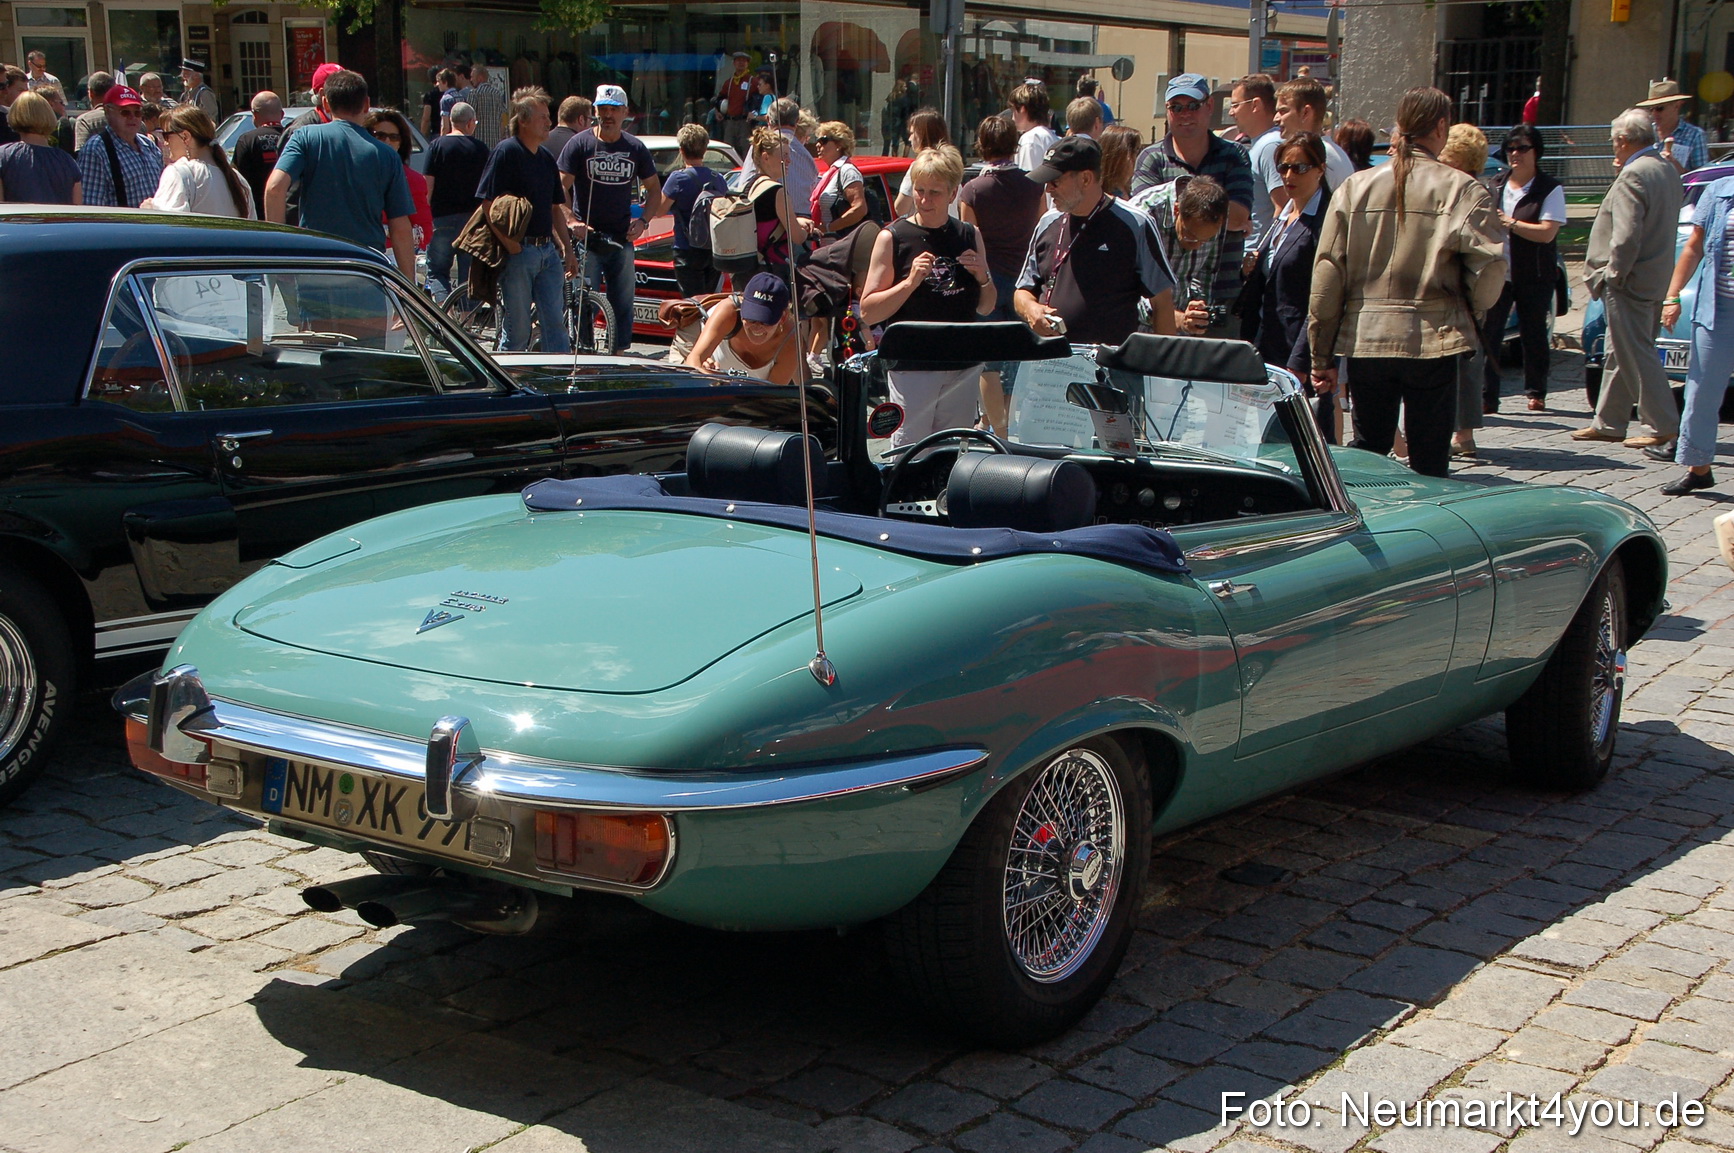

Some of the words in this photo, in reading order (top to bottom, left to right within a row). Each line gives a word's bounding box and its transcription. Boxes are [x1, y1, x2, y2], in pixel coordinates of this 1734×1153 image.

[590, 160, 631, 178] ROUGH
[753, 290, 773, 302] MAX
[1666, 351, 1688, 367] NM
[270, 787, 278, 802] D
[284, 764, 335, 817] NM
[356, 777, 409, 835] XK
